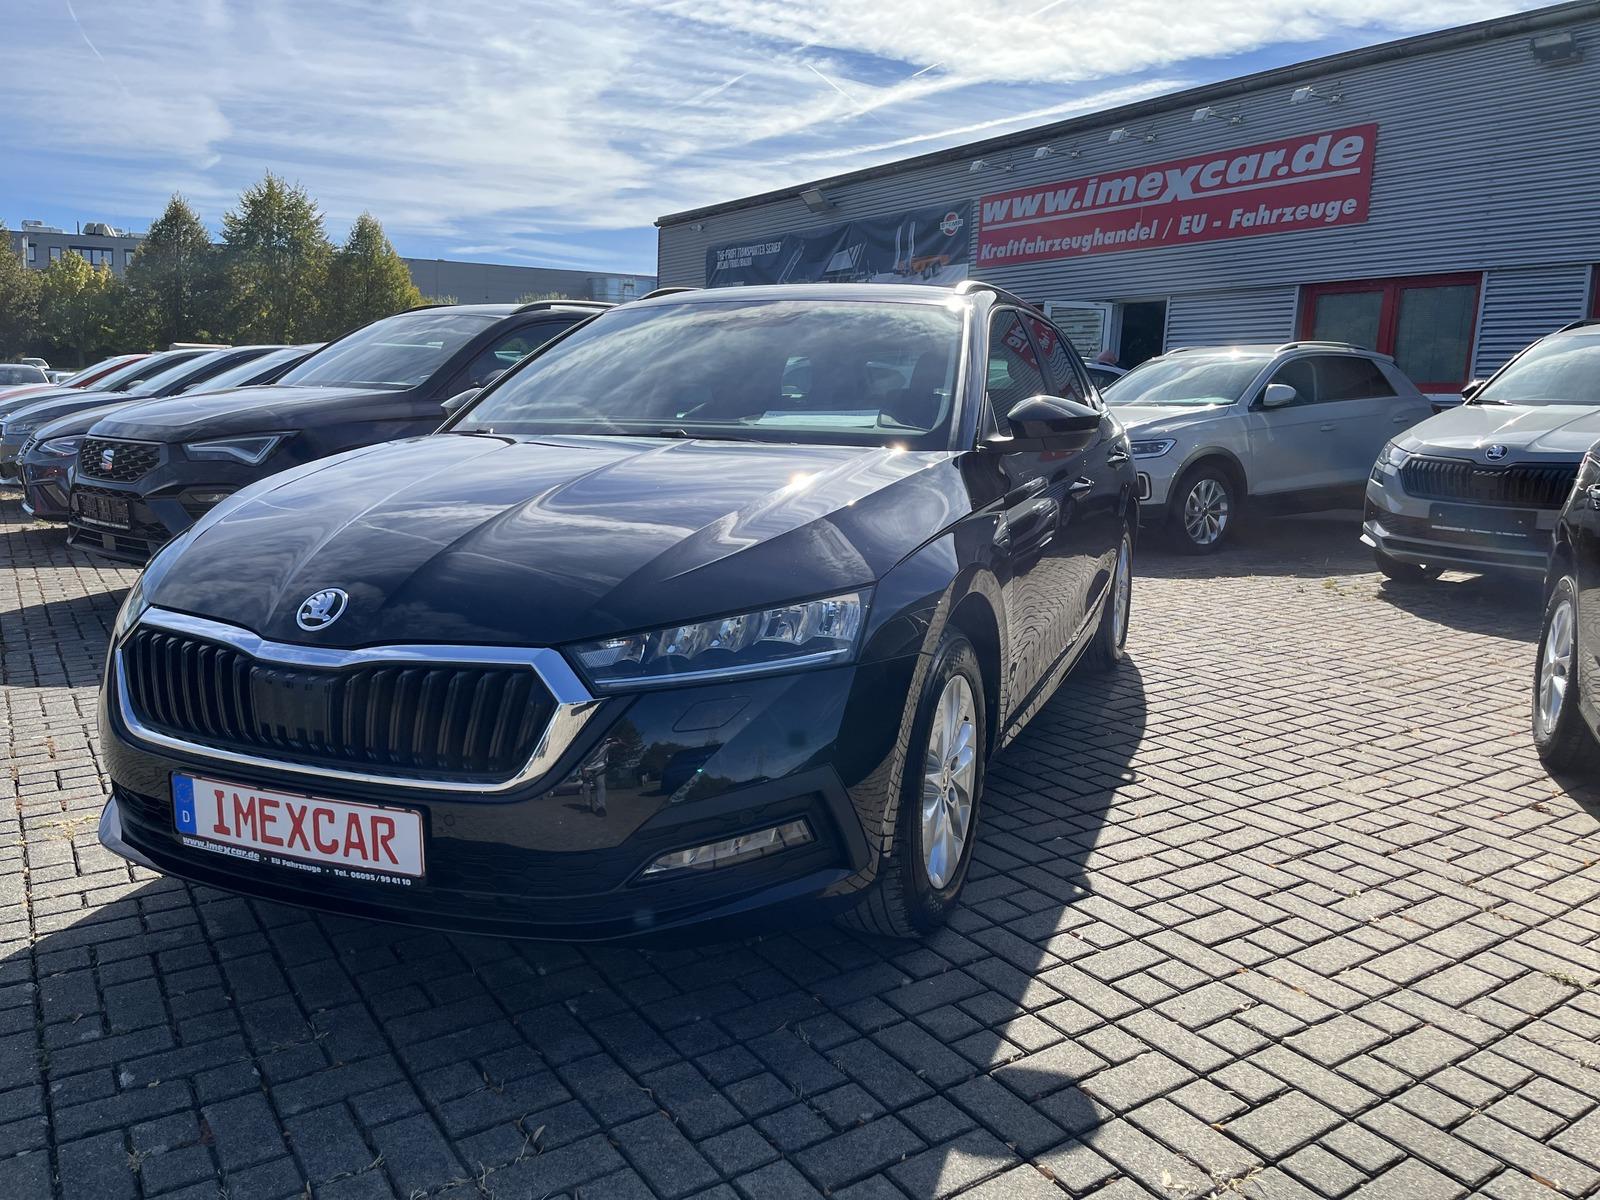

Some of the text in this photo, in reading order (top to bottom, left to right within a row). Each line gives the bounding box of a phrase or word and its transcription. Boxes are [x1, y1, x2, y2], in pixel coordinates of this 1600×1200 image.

[982, 134, 1365, 223] www.imexcar.de
[980, 220, 1157, 261] Kraftfahrzeughandel
[1161, 217, 1173, 240] /
[1178, 213, 1208, 236] EU
[1229, 198, 1358, 230] Fahrzeuge
[182, 810, 190, 823] D
[213, 789, 399, 865] IMEXCAR
[182, 836, 260, 860] www.imexcar.de
[271, 857, 281, 865] EU
[282, 859, 322, 873] Fahrzeuge
[334, 869, 349, 878] Tel.
